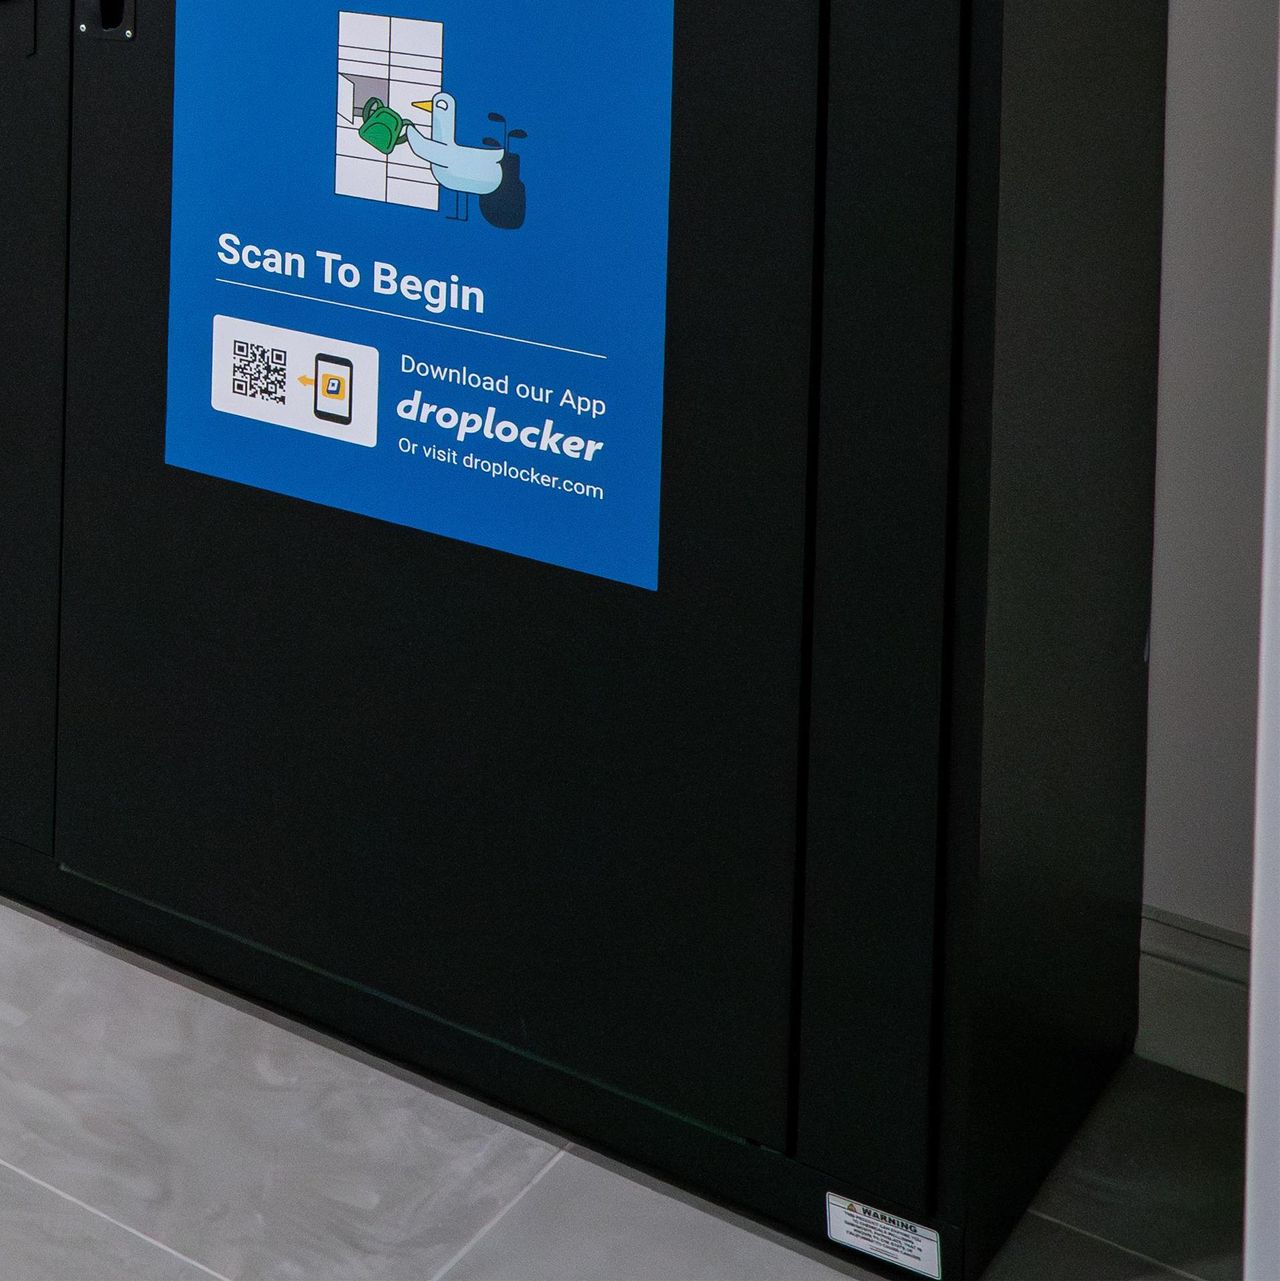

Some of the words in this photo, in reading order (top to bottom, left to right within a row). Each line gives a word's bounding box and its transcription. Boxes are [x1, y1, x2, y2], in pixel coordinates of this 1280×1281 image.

[216, 232, 305, 279] Scan
[316, 250, 361, 288] To
[373, 261, 485, 314] Begin
[401, 354, 510, 395] Download
[515, 380, 554, 404] our
[559, 388, 607, 418] App
[396, 390, 604, 462] droplocker
[398, 438, 418, 457] Or
[423, 442, 458, 466] visit
[462, 452, 605, 500] droplocker.com
[862, 1207, 918, 1233] WARNING
